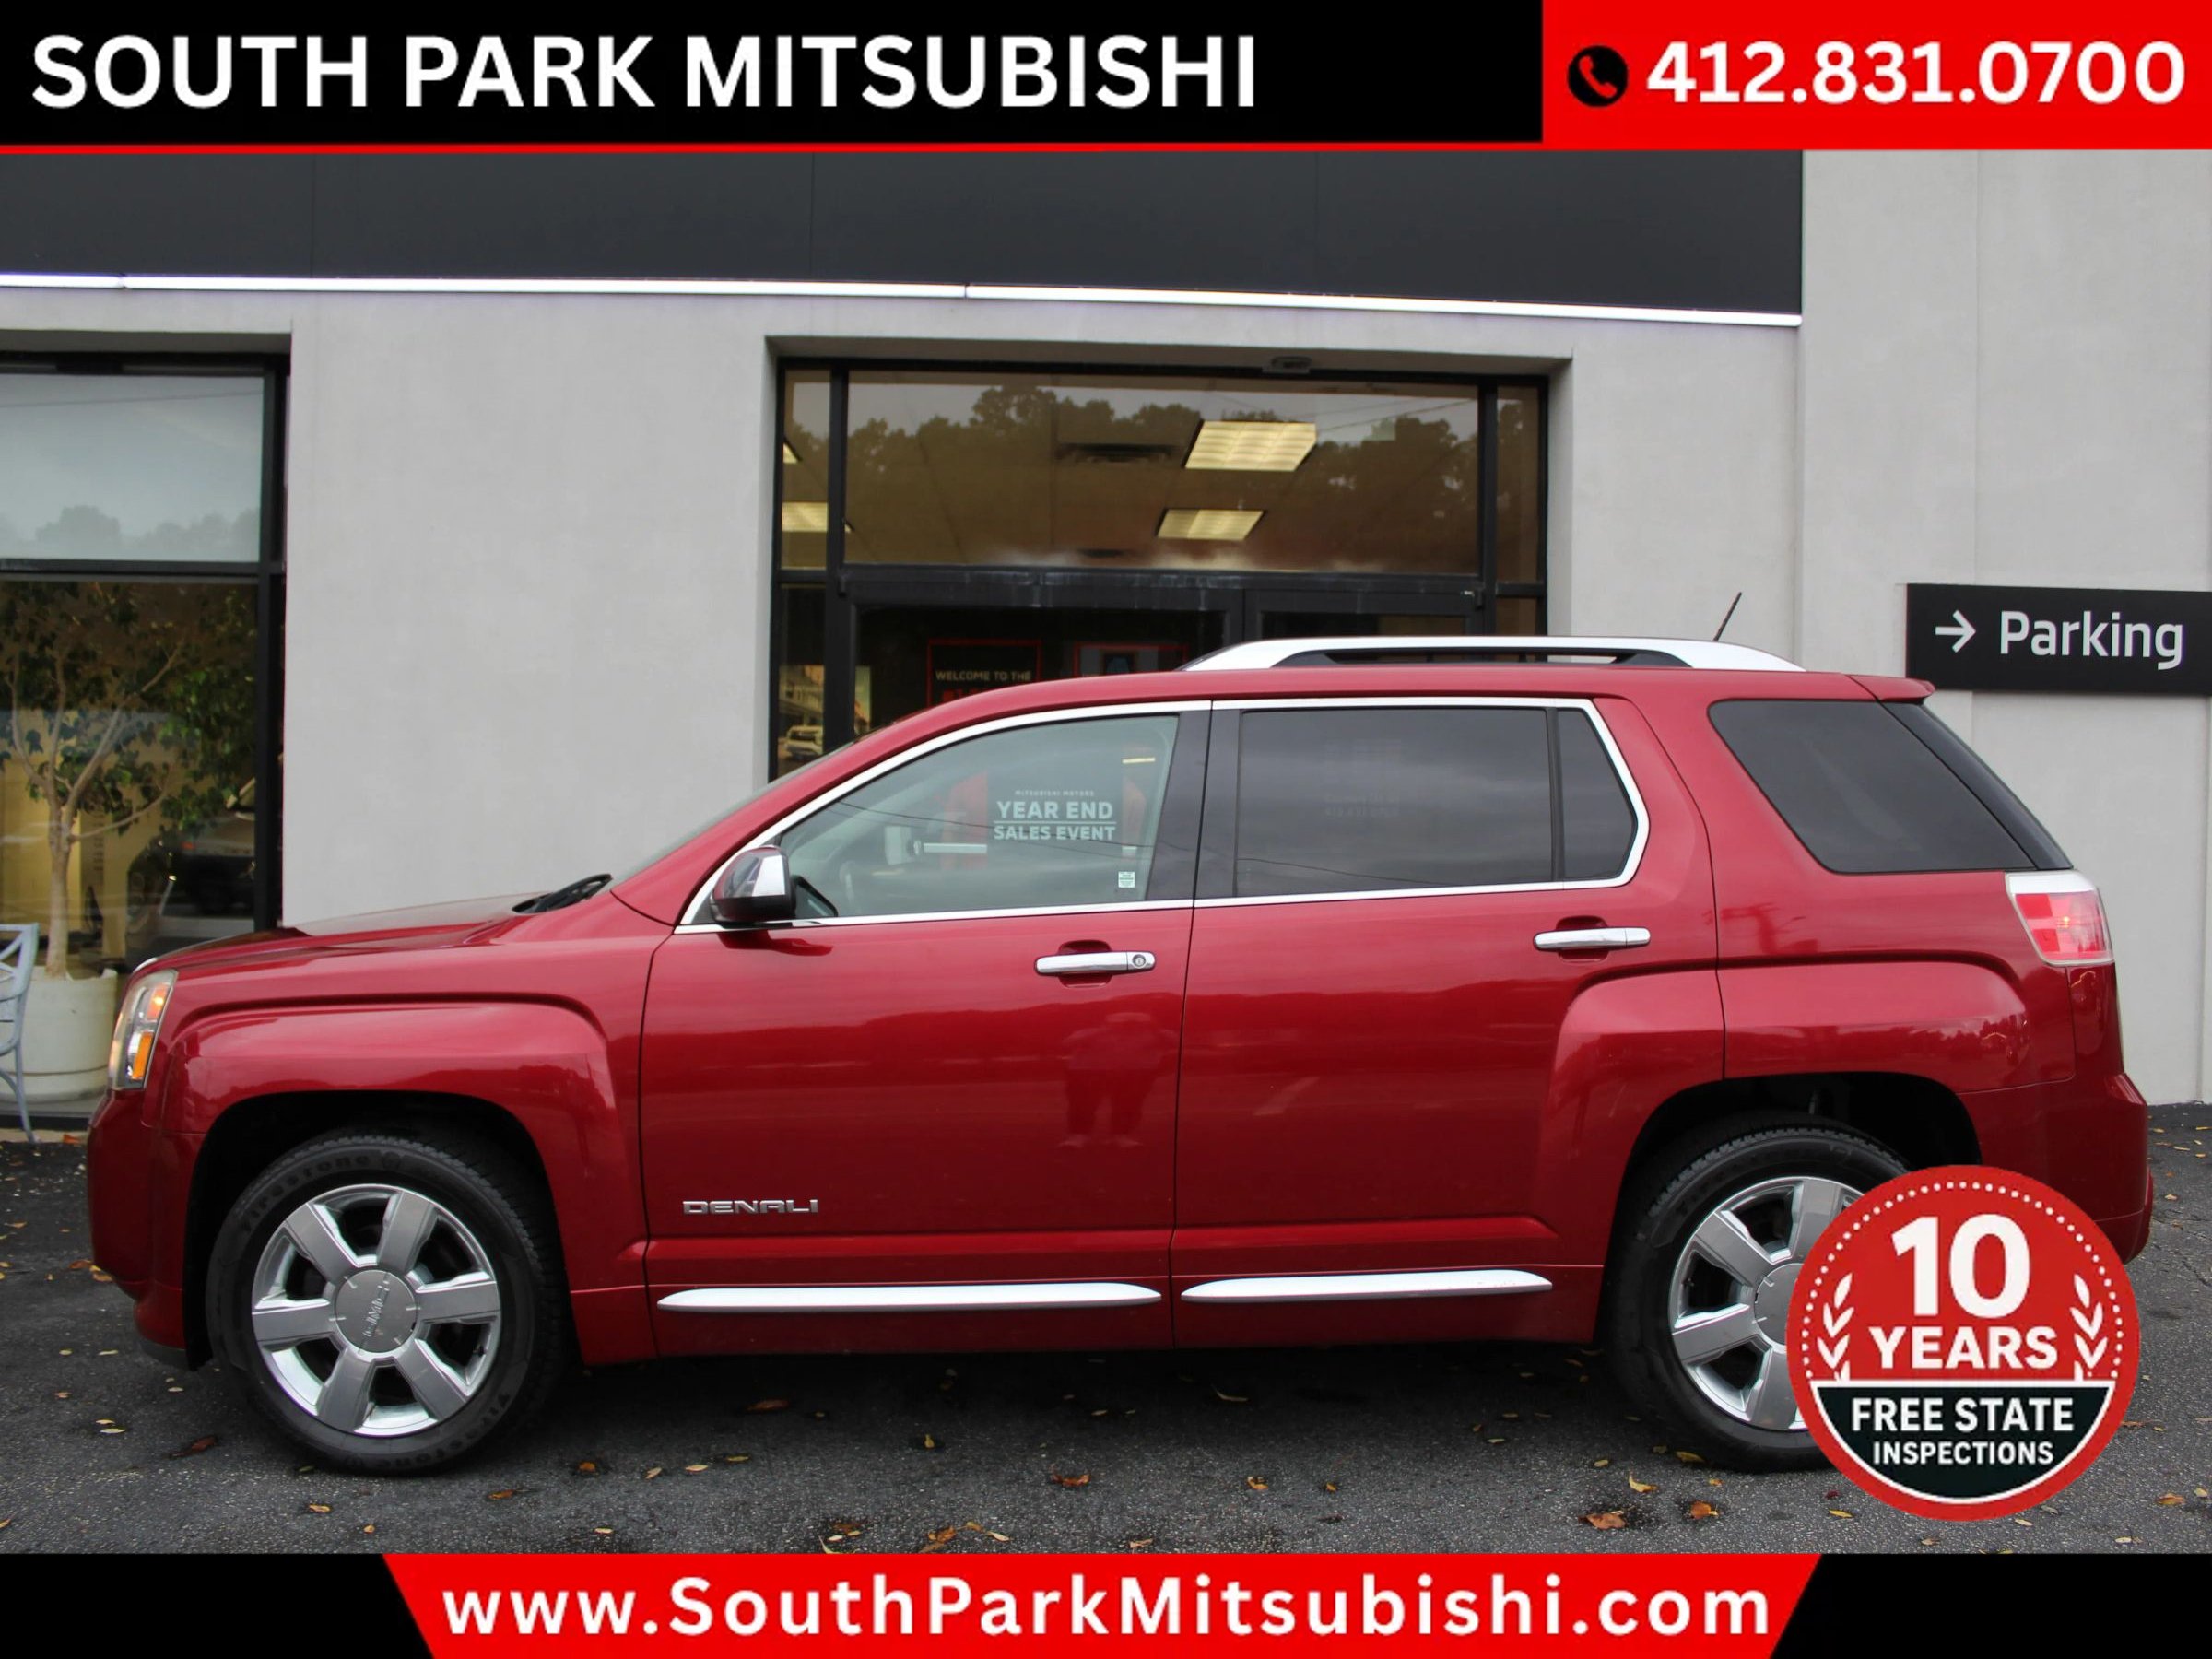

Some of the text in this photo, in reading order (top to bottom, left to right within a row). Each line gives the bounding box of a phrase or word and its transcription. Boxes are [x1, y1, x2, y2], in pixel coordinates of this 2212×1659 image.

[2000, 610, 2183, 671] Parking
[935, 670, 1032, 681] WELCOME TO THE
[996, 800, 1113, 819] YEAR END
[994, 826, 1117, 841] SALES EVENT
[682, 1199, 819, 1214] DENALI
